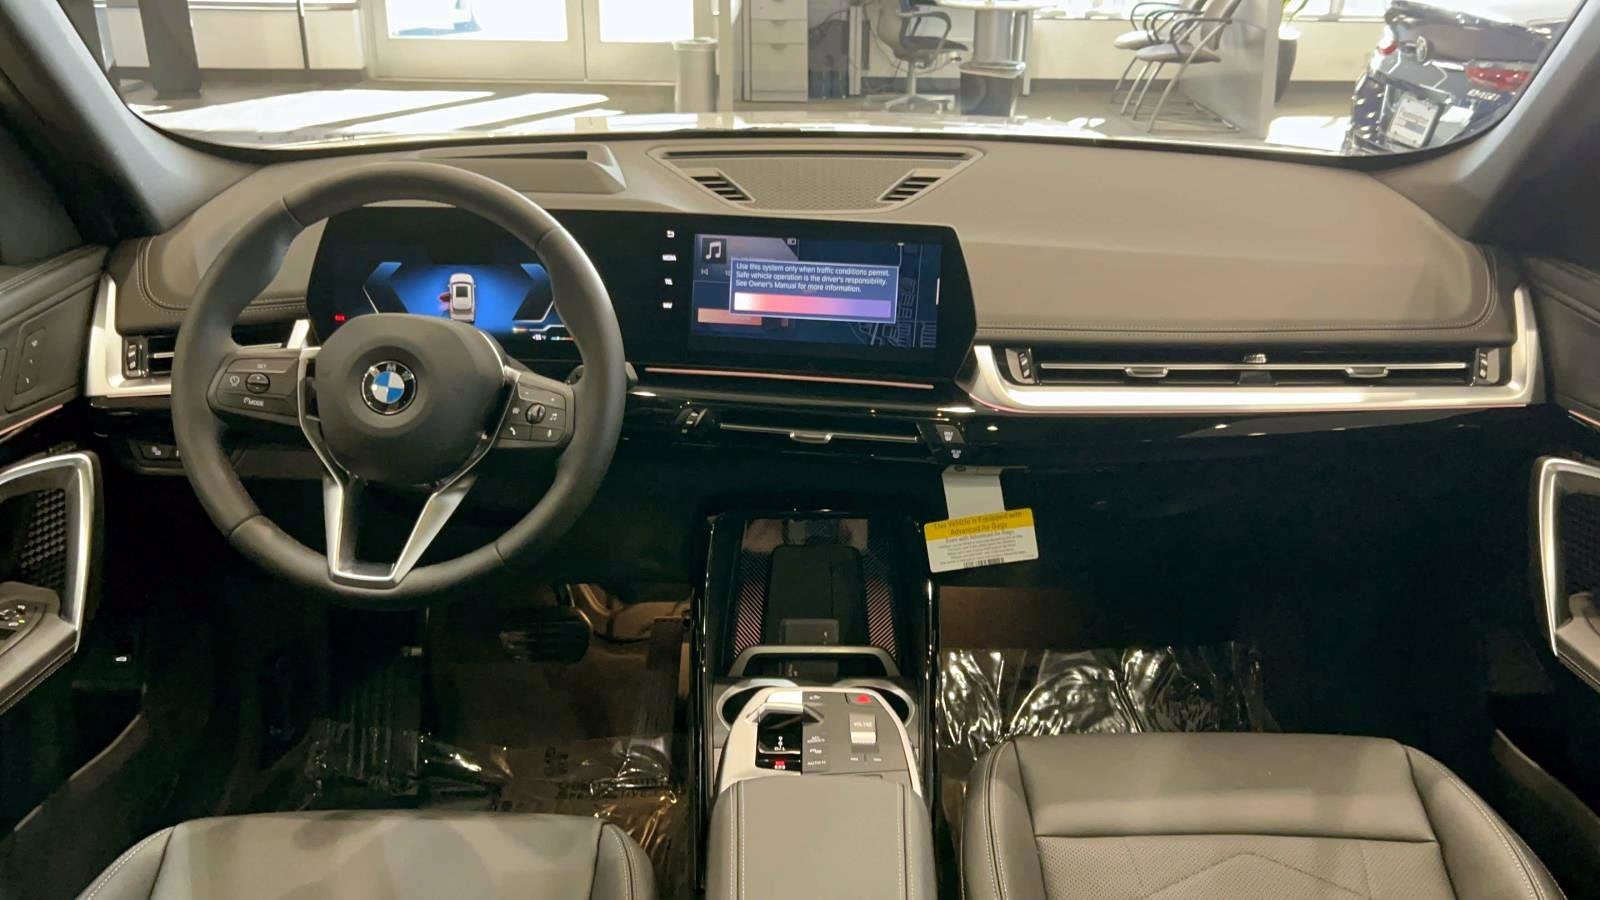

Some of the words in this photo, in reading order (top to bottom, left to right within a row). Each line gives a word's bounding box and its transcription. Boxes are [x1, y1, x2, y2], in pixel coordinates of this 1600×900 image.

[750, 263, 762, 271] this
[762, 264, 784, 273] system
[784, 265, 798, 273] only
[816, 266, 834, 274] traffic
[835, 268, 867, 276] conditions
[773, 274, 803, 282] operation
[821, 275, 844, 283] driver's
[748, 280, 773, 288] Owner's
[774, 281, 797, 289] Manual
